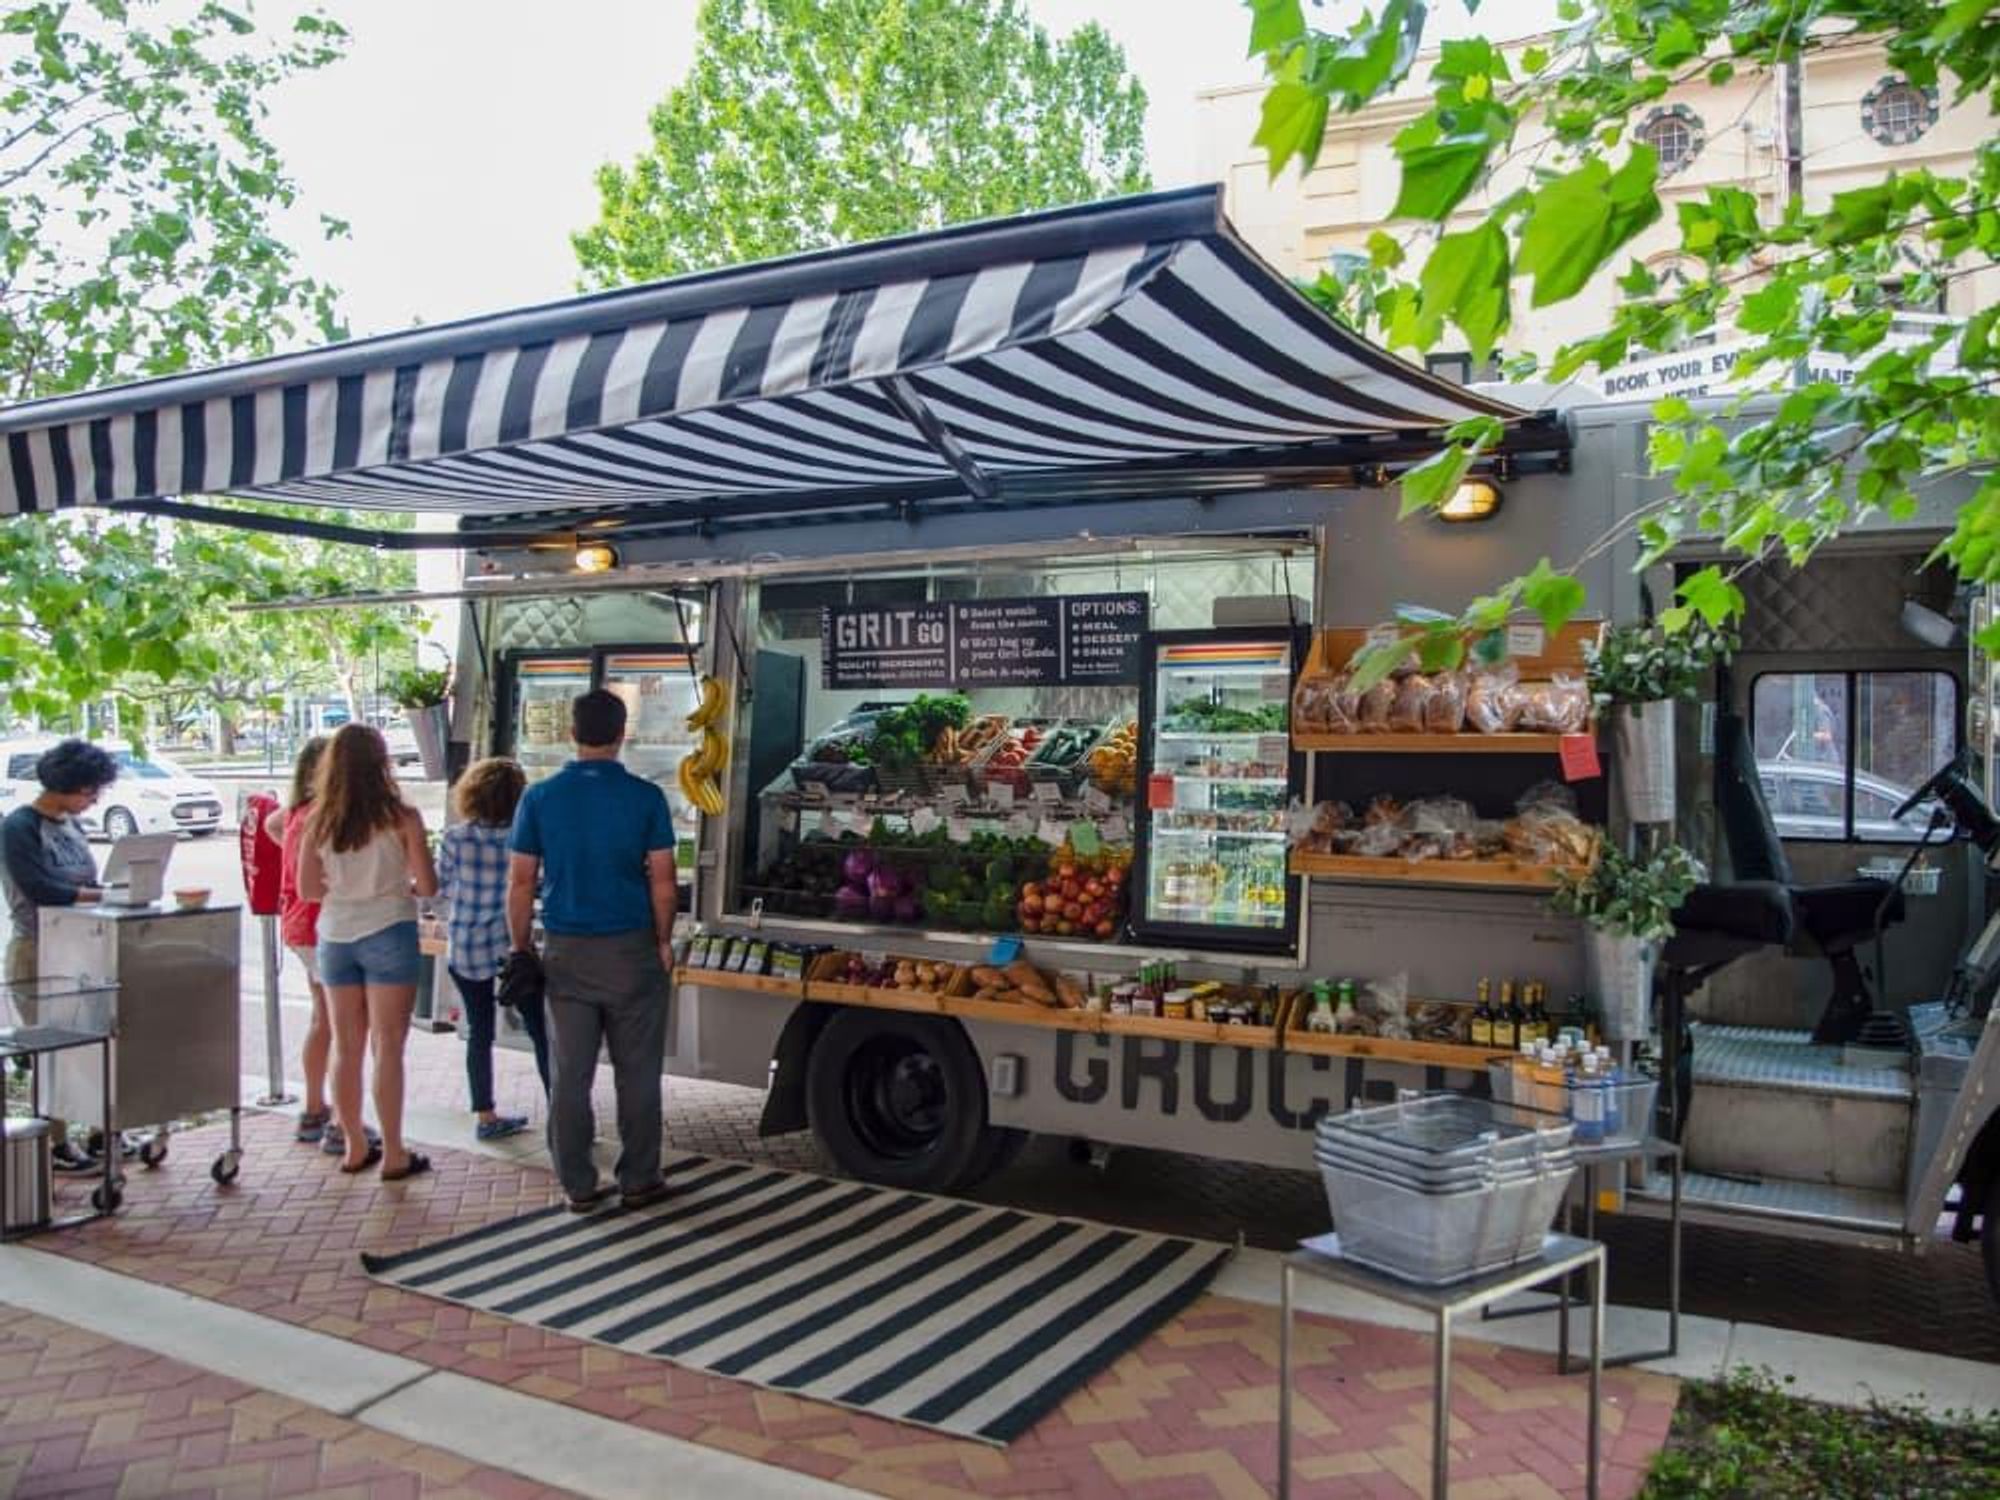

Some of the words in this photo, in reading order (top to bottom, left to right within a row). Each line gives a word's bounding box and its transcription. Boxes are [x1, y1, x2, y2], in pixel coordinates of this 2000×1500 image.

[1605, 372, 1650, 396] BOOK
[1658, 360, 1702, 383] YOUR
[1806, 367, 1856, 384] MAJE
[970, 607, 1002, 618] Select
[1071, 600, 1141, 618] OPTIONS:
[837, 612, 916, 648] GRIT
[917, 621, 944, 644] GO
[1082, 621, 1119, 631] MEAL
[1082, 633, 1140, 645] DESSERT
[1082, 647, 1124, 657] SNACK
